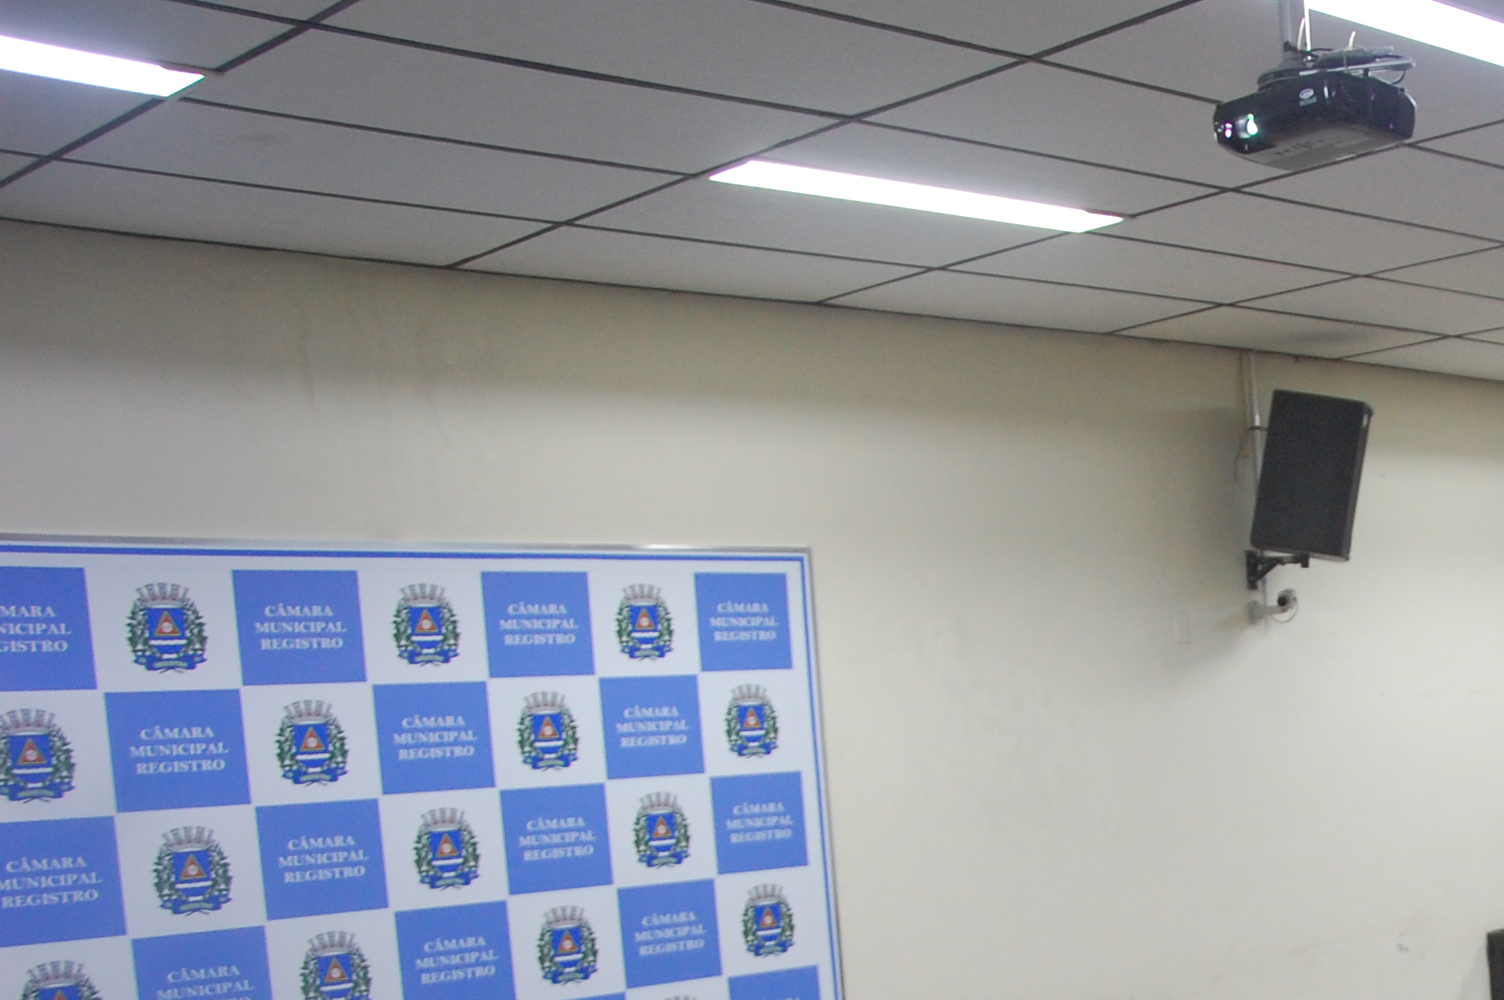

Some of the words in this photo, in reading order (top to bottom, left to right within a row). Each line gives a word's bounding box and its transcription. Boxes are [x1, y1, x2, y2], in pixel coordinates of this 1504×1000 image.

[0, 605, 55, 617] MARA
[264, 603, 333, 617] CÂMARA
[507, 602, 567, 615] CÂMARA
[717, 601, 768, 613] CÂMARA
[255, 621, 346, 633] MUNICIPAL
[499, 618, 578, 630] MUNICIPAL
[710, 616, 778, 627] MUNICIPAL
[504, 633, 575, 645] REGISTRO
[714, 630, 776, 641] REGISTRO
[260, 637, 343, 650] REGISTRO
[623, 705, 678, 718] CÂMARA
[401, 714, 465, 728] CÂMARA
[616, 719, 688, 732] MUNICIPAL
[139, 725, 214, 740] CÂMARA
[393, 730, 477, 744] MUNICIPAL
[620, 734, 687, 747] REGISTRO
[130, 742, 229, 757] MUNICIPAL
[398, 745, 474, 760] REGISTRO
[136, 759, 225, 774] REGISTRO
[732, 802, 784, 816] CÂMARA
[526, 817, 585, 831] CÂMARA
[726, 815, 793, 830] MUNICIPAL
[287, 835, 355, 850] CÂMARA
[519, 830, 596, 846] MUNICIPAL
[729, 828, 792, 843] REGISTRO
[278, 849, 367, 866] MUNICIPAL
[523, 845, 594, 861] REGISTRO
[5, 856, 86, 873] CÂMARA
[284, 865, 365, 883] REGISTRO
[2, 889, 99, 908] REGISTRO
[641, 911, 696, 927] CÂMARA
[634, 924, 705, 942] MUNICIPAL
[423, 936, 486, 952] CÂMARA
[638, 939, 704, 956] REGISTRO
[415, 949, 497, 969] MUNICIPAL
[166, 965, 240, 983] CÂMARA
[421, 965, 495, 984] REGISTRO
[156, 979, 254, 1000] MUNICIPAL
